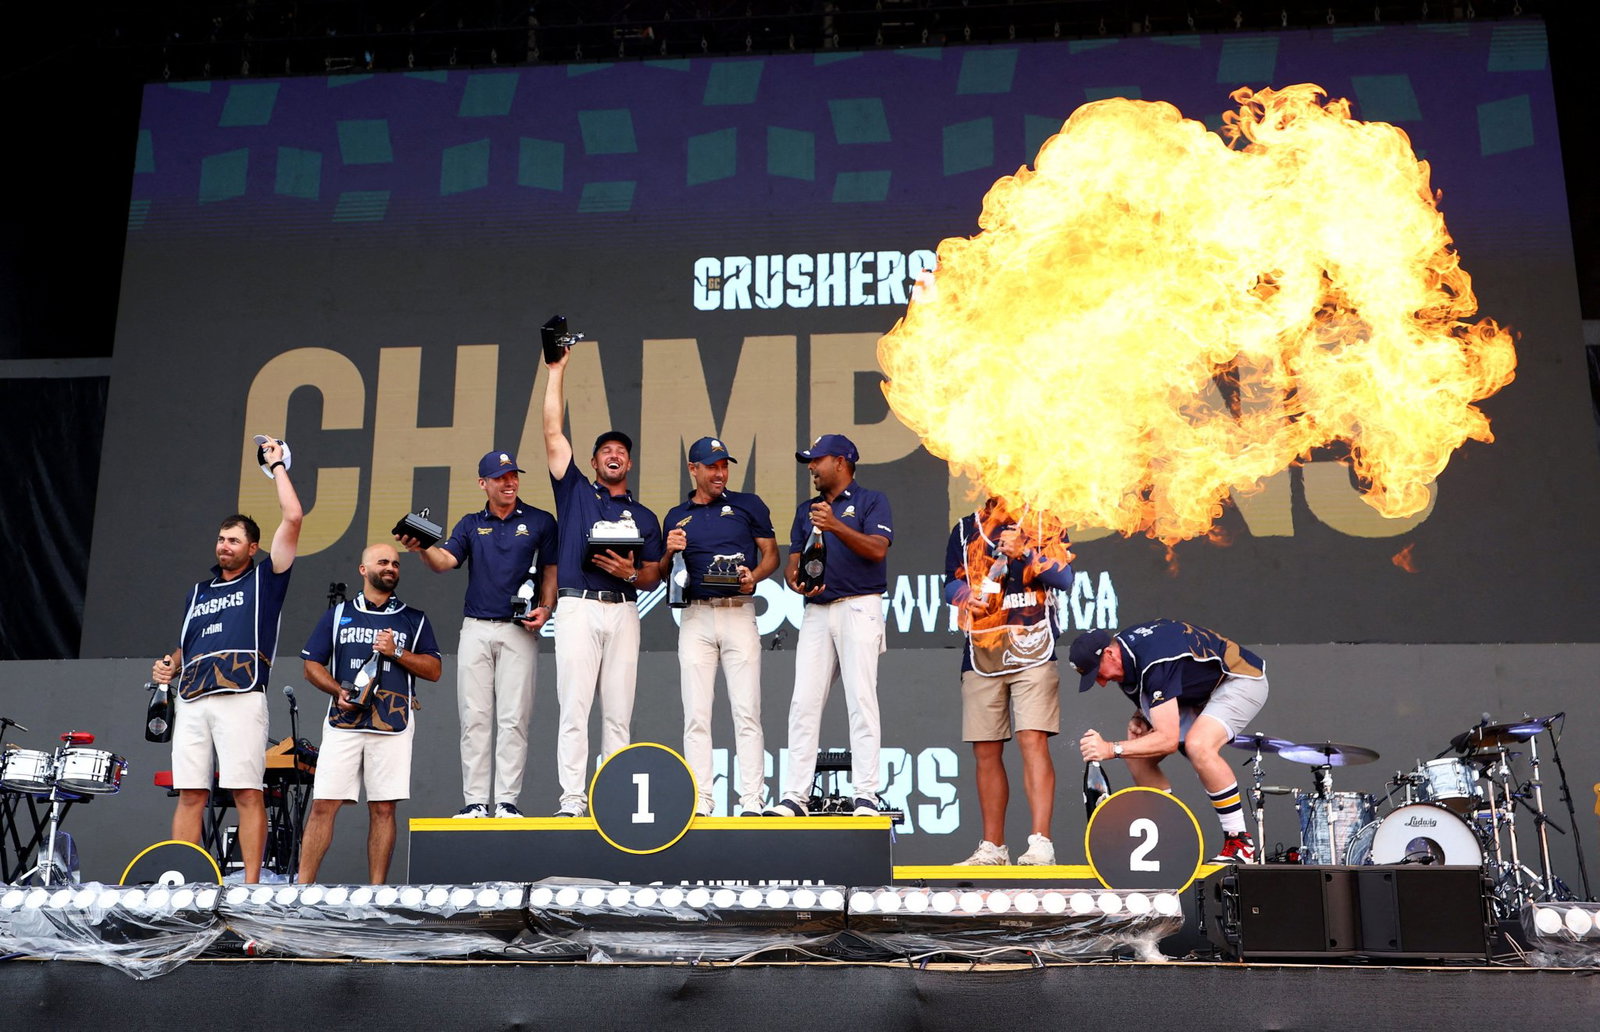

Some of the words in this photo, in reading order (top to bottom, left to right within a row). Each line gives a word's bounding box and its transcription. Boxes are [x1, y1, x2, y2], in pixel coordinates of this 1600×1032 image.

[693, 250, 938, 311] CRUSHERS
[708, 278, 721, 290] GC
[631, 772, 655, 824] 1
[1404, 815, 1438, 828] Ludwig
[1128, 818, 1160, 872] 2
